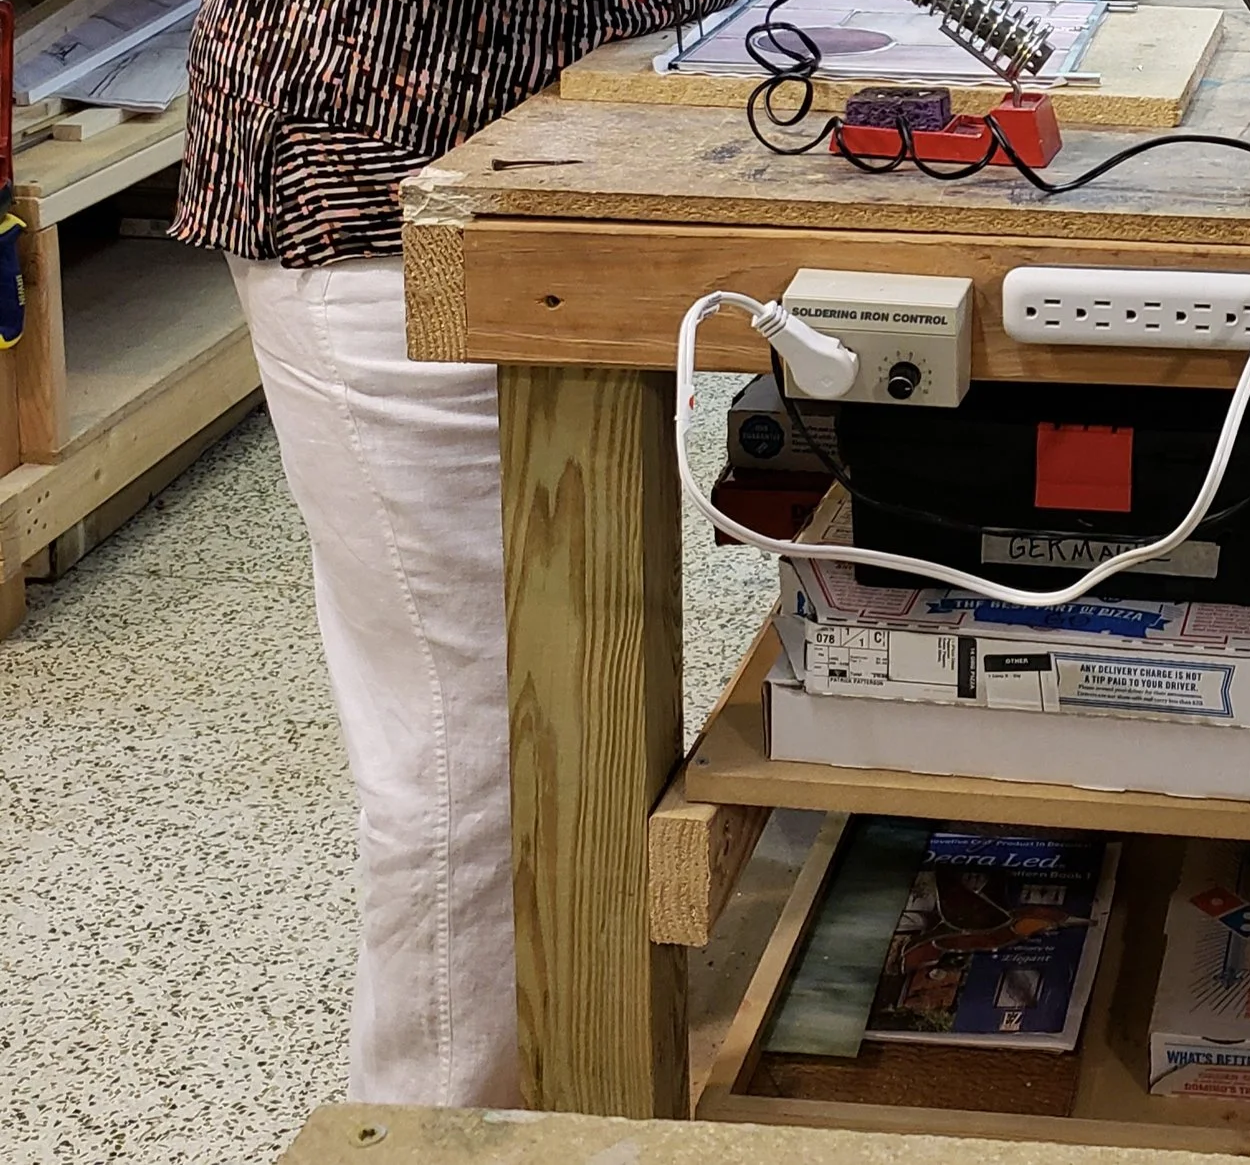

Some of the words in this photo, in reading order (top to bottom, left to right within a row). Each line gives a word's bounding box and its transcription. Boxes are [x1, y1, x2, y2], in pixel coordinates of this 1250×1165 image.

[791, 307, 857, 320] SOLDERING
[860, 311, 889, 322] IRON
[893, 313, 948, 325] CONTROL
[1097, 607, 1143, 621] PIZZA
[816, 632, 835, 644] 078
[1080, 663, 1097, 674] ANY
[1098, 665, 1138, 677] DELIVERY
[1140, 669, 1173, 679] CHARGE
[1175, 671, 1184, 680] IS
[1186, 672, 1203, 682] NOT
[1084, 675, 1090, 683] A
[1092, 675, 1106, 684] TIP
[1107, 677, 1127, 686] PAID
[1129, 678, 1139, 687] TO
[1141, 679, 1164, 689] YOUR
[1165, 681, 1198, 692] DRIVER.
[996, 840, 1034, 848] Product
[1002, 852, 1062, 868] Led
[1167, 1050, 1213, 1066] WHAT'S
